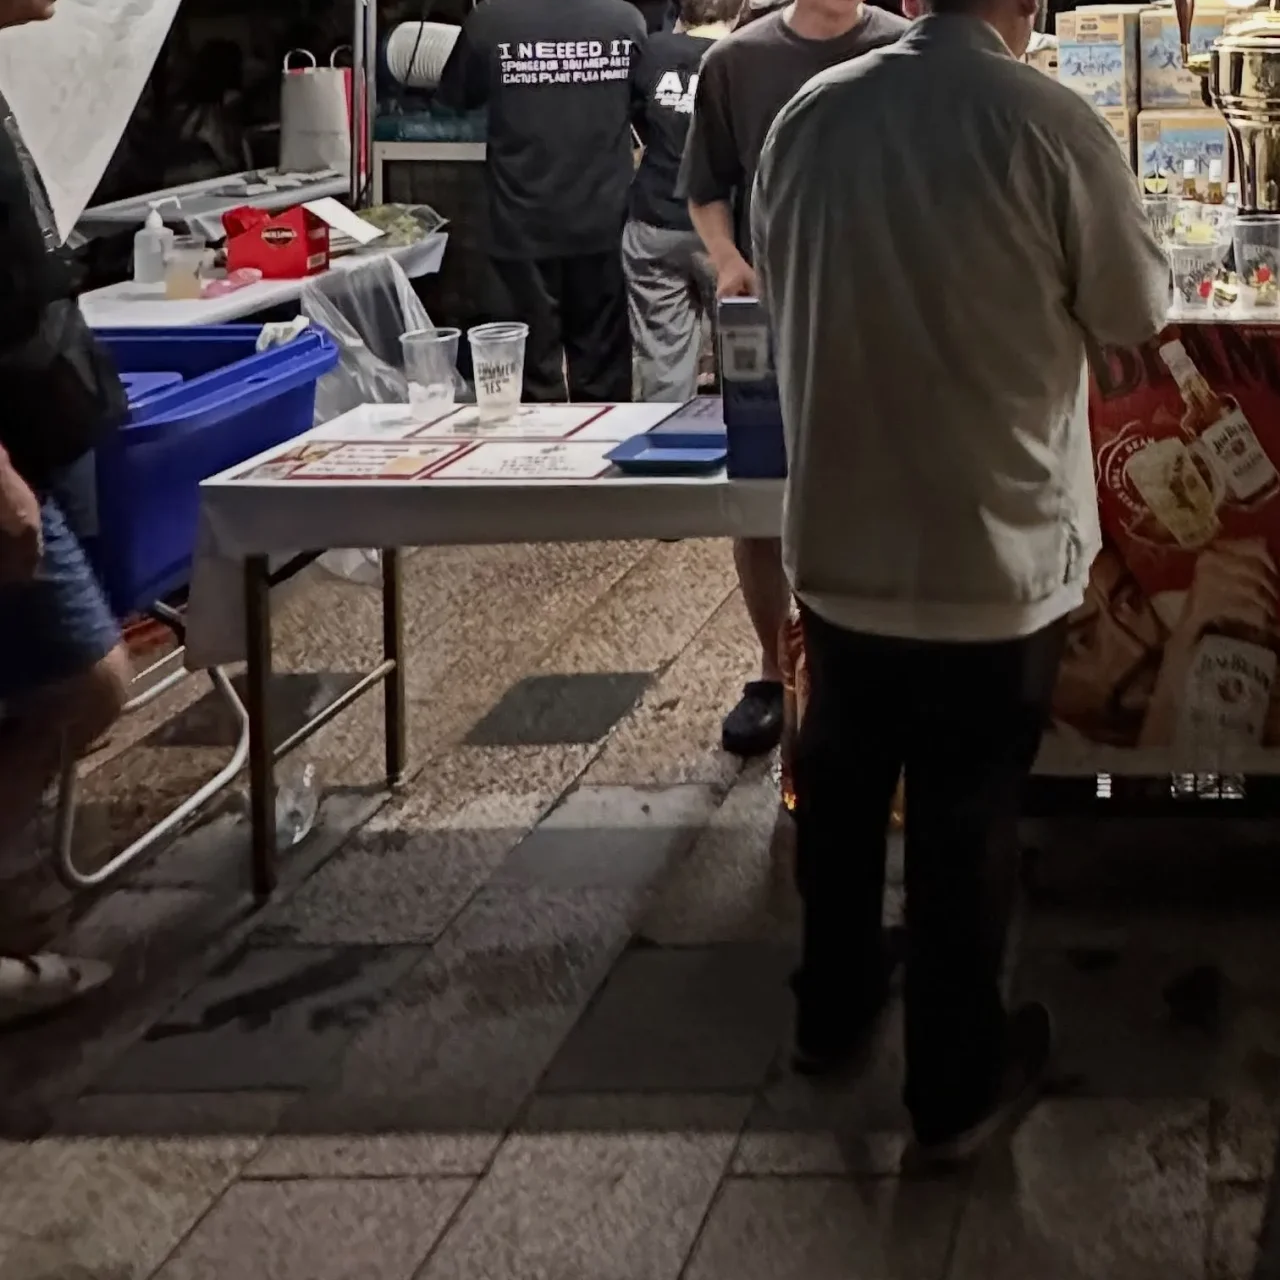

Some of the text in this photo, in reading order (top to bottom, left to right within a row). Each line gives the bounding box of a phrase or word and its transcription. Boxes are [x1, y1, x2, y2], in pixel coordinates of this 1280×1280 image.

[498, 39, 633, 60] I NEEEED IT
[502, 72, 537, 84] CACTUS
